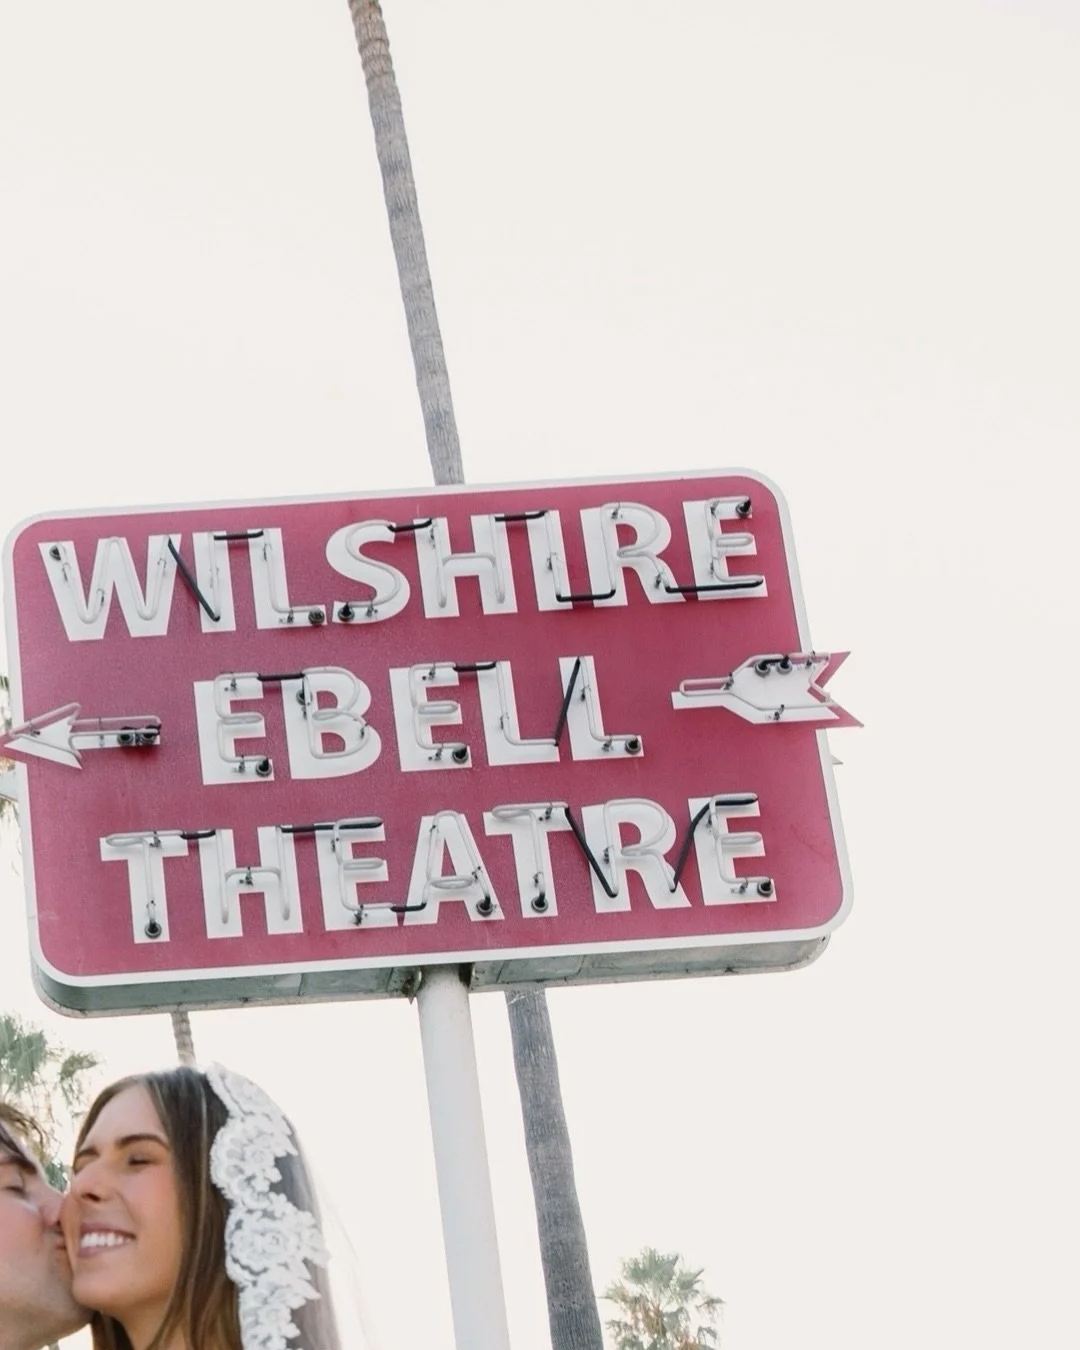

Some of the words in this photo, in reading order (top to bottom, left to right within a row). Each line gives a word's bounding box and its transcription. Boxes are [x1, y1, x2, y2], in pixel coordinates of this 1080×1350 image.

[38, 497, 768, 640] WILSHIRE
[193, 656, 644, 784] EBELL
[100, 796, 777, 943] THEATRE
